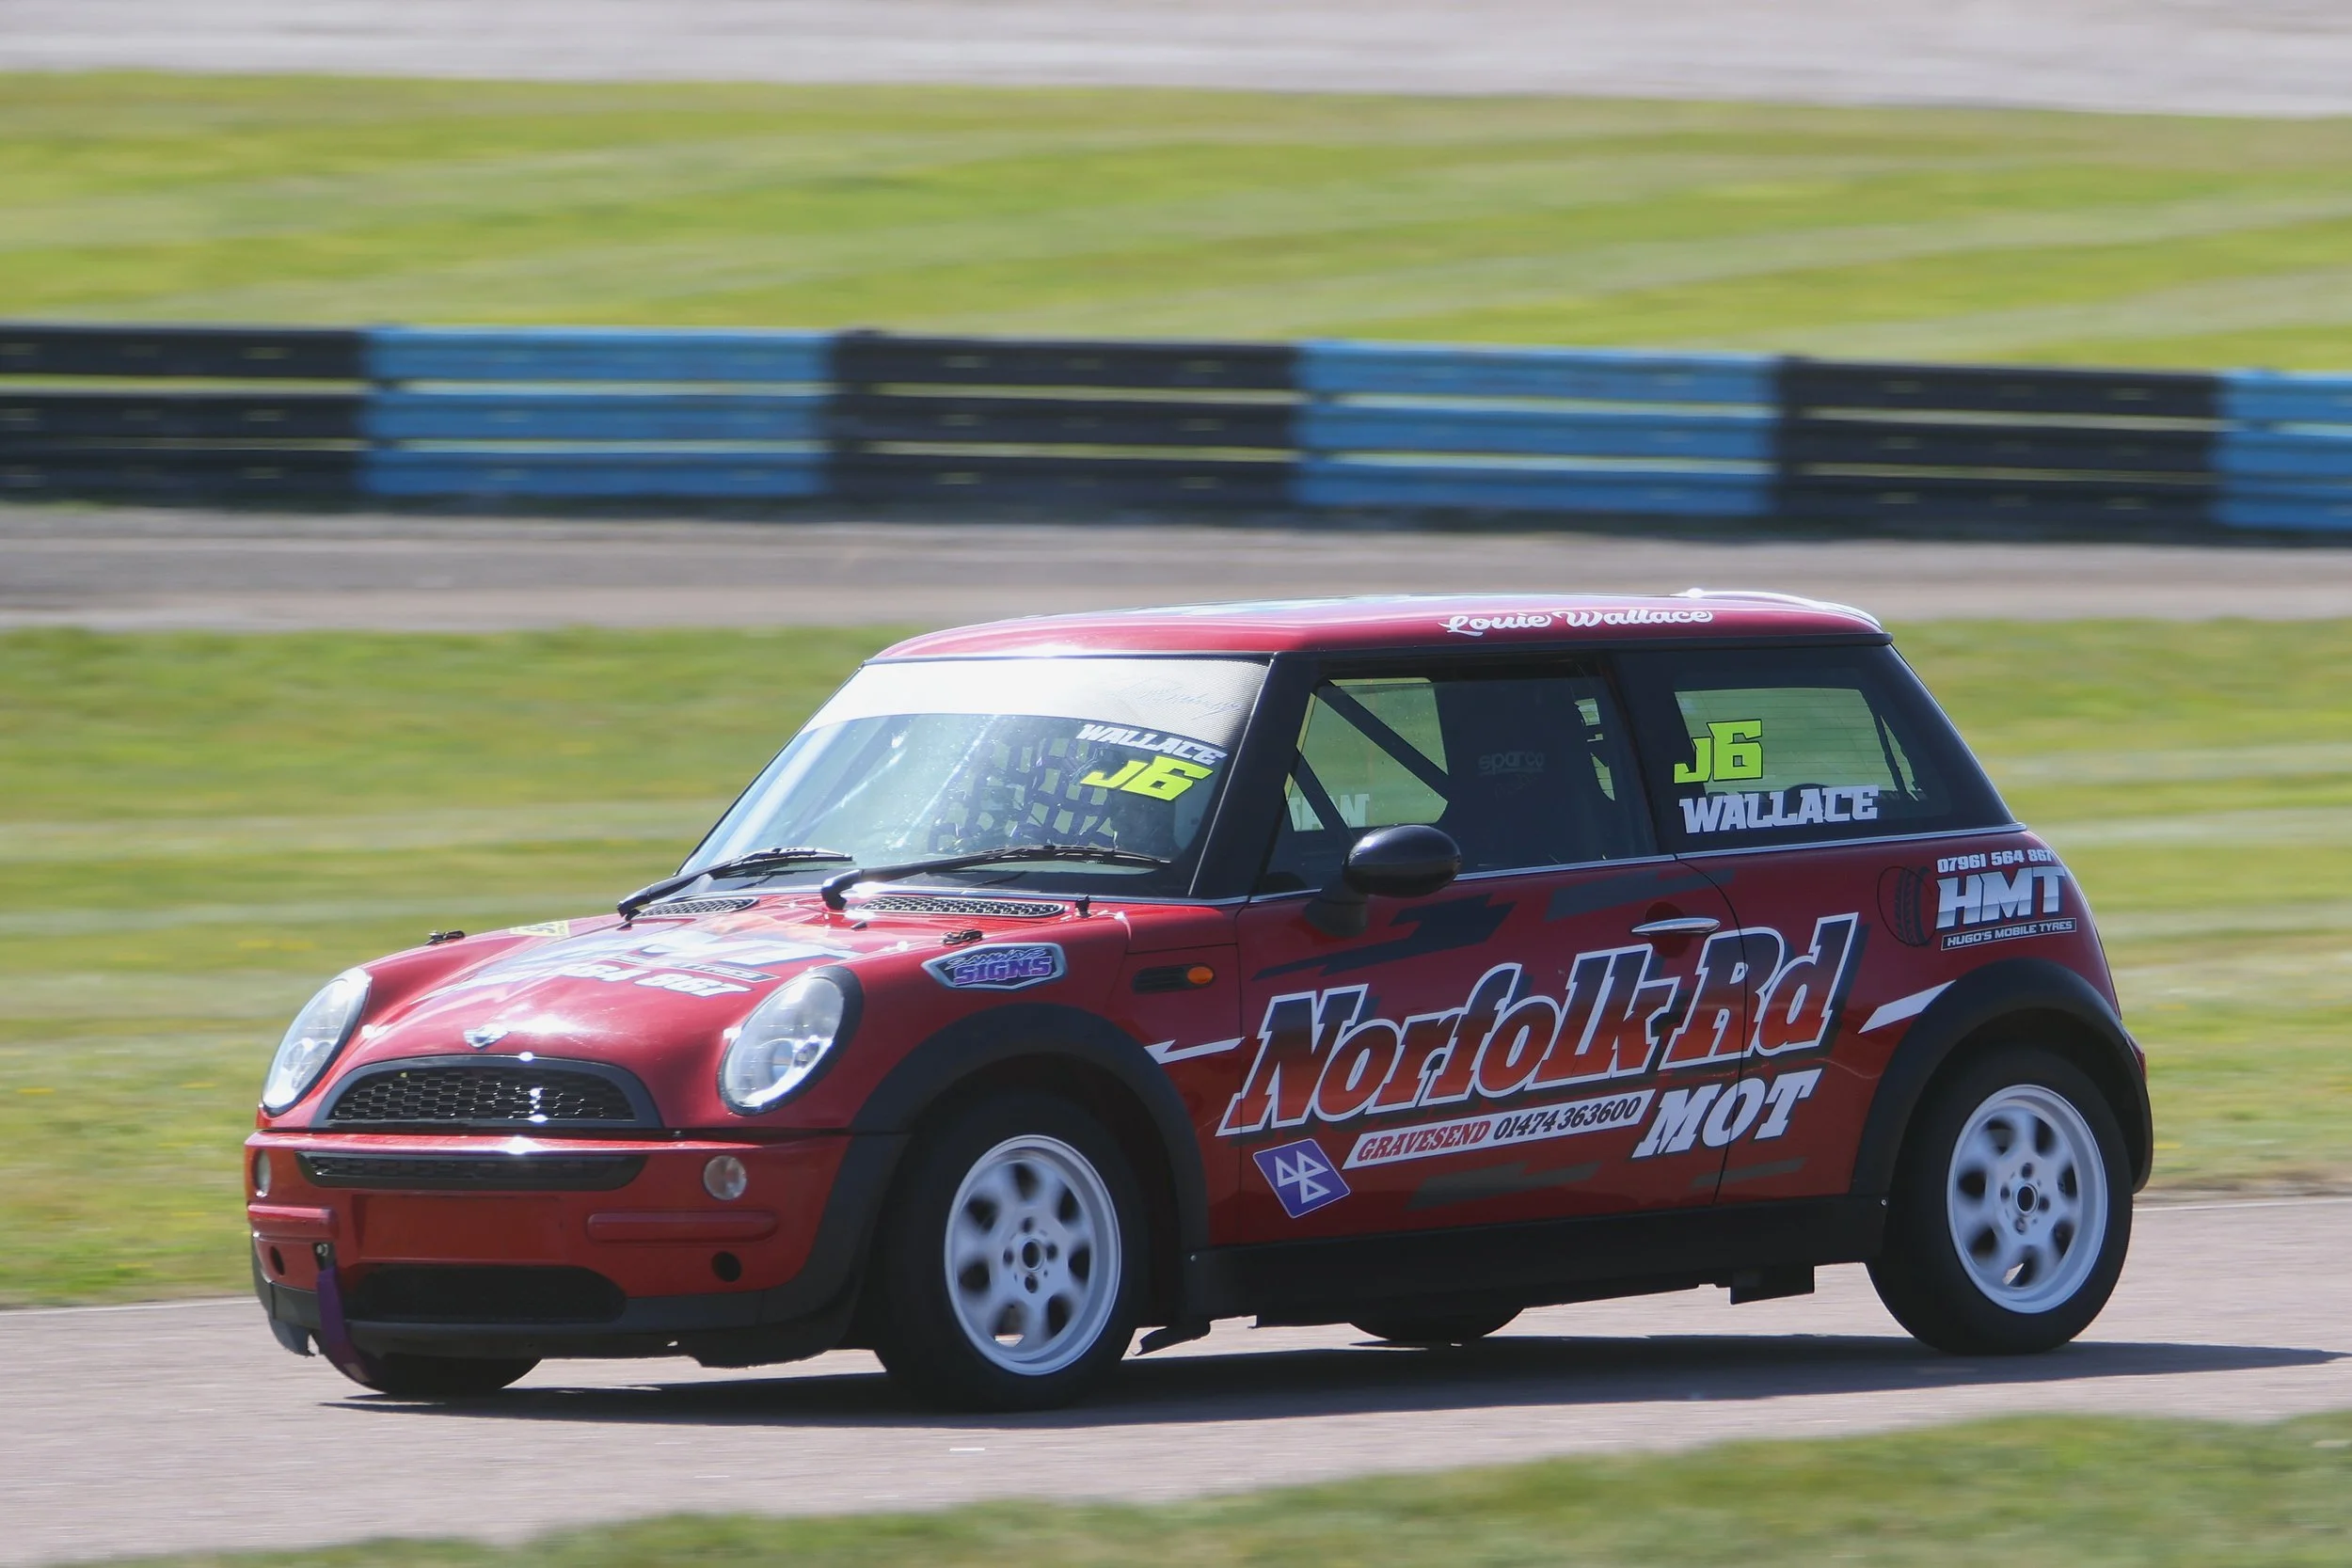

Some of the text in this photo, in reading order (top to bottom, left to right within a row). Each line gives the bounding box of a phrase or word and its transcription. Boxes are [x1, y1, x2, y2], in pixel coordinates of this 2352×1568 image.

[1438, 610, 1713, 637] Louie Wallace
[1075, 723, 1228, 766] WALLACE
[1478, 750, 1545, 775] sparco
[1674, 720, 1763, 784] J6
[1080, 755, 1214, 801] J6
[1679, 784, 1879, 833] WALLACE
[1937, 848, 2055, 873] 07961 564 867
[1936, 865, 2066, 929] HMT
[1947, 920, 2074, 947] HUGO'S MOBILE TYRES
[953, 955, 1054, 987] SIGNS
[1216, 912, 1859, 1136] Norfolk Rd
[1357, 1096, 1642, 1163] GRAVESEND 01474 363600
[1631, 1068, 1823, 1159] MOT
